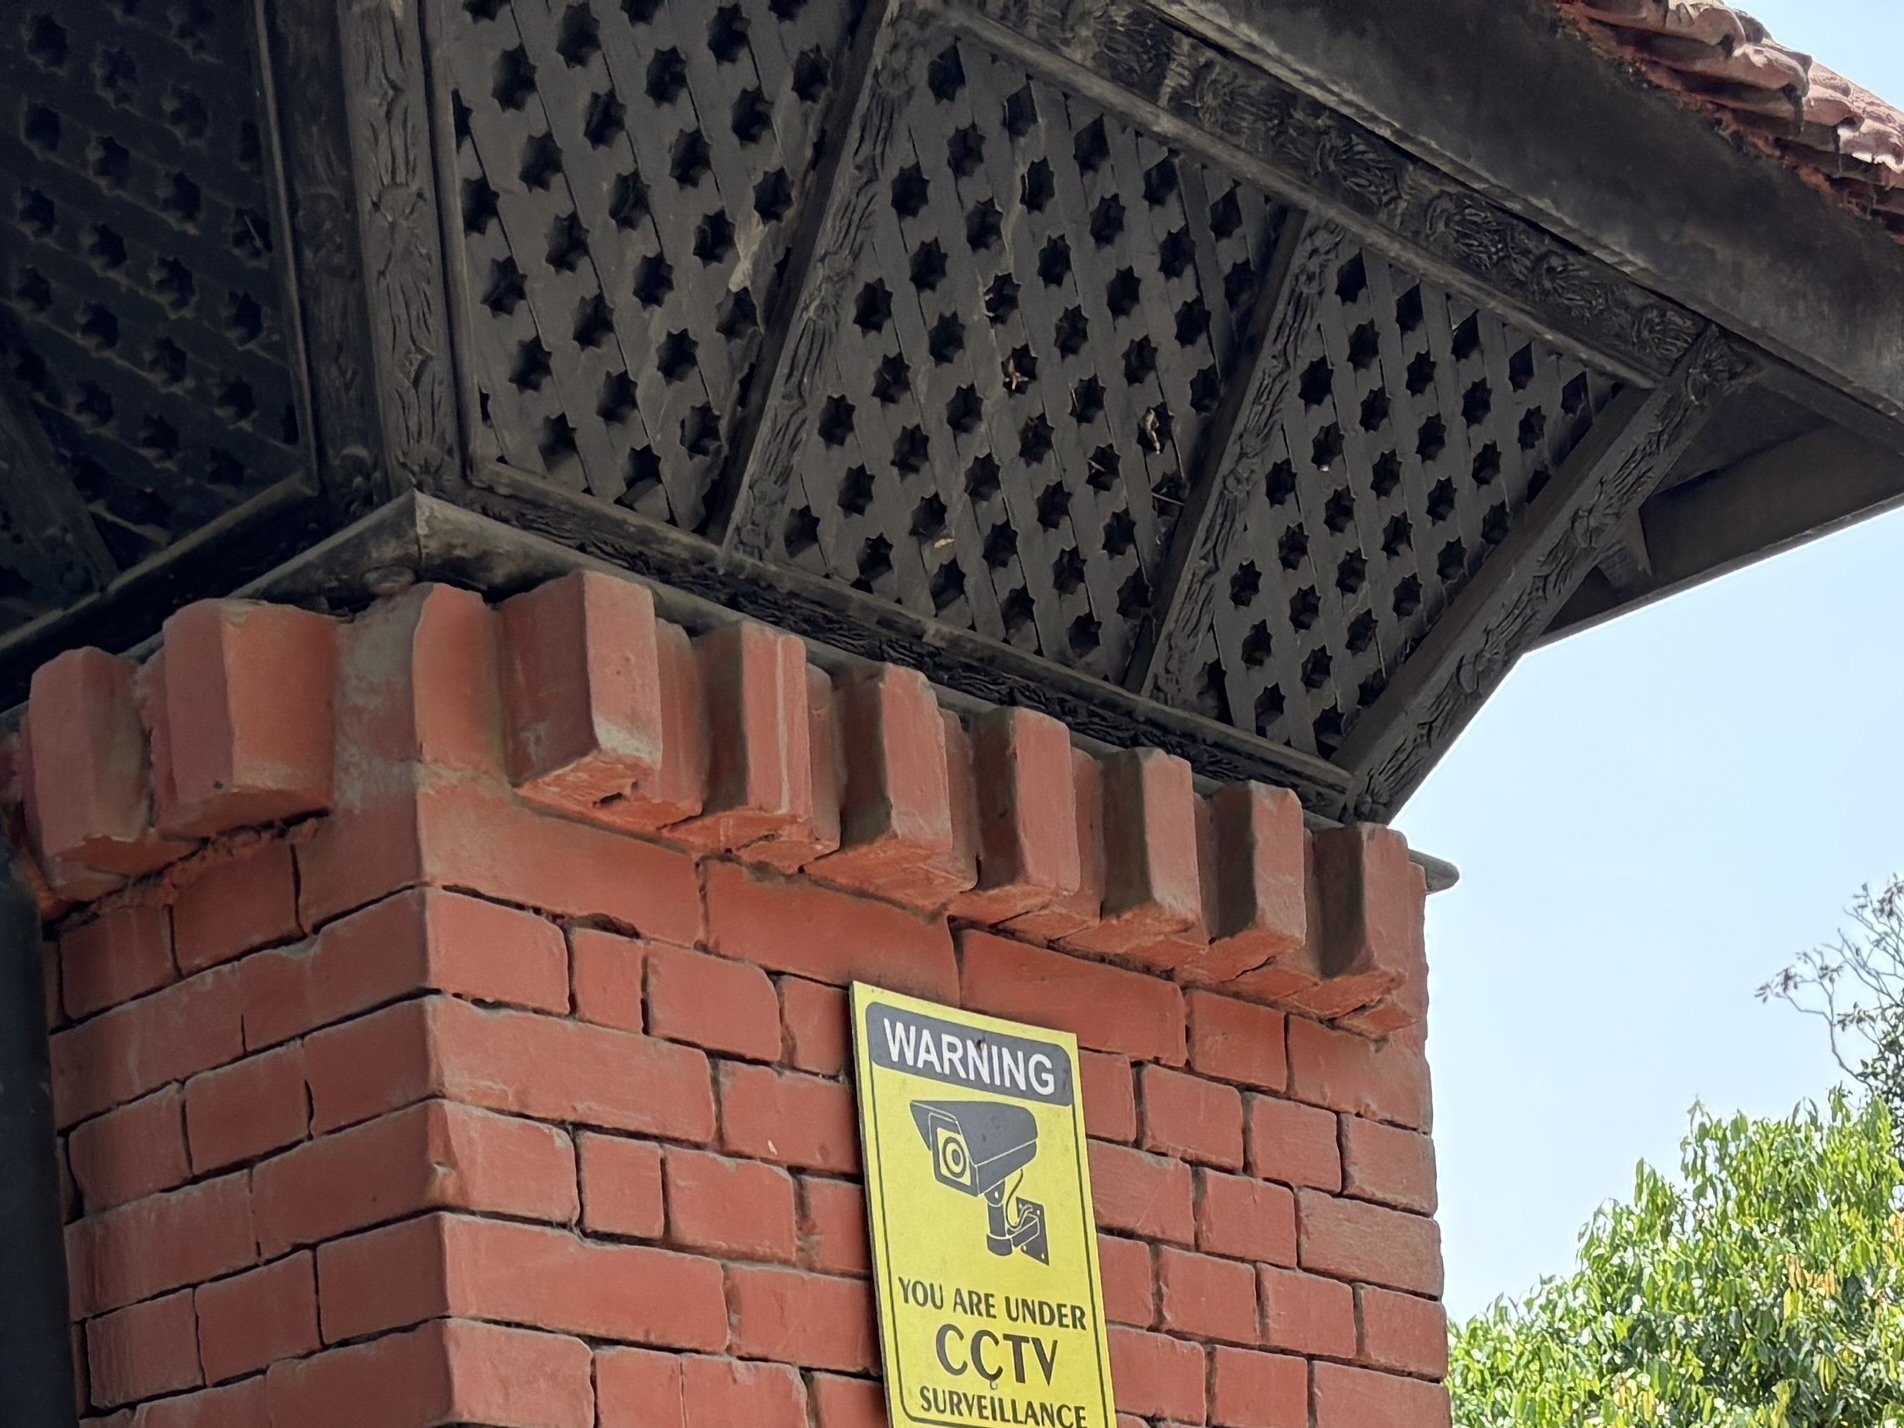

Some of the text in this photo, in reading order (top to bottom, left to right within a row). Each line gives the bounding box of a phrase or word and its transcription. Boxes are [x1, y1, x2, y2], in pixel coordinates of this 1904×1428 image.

[883, 1017, 1056, 1096] WARNING
[898, 1276, 1087, 1331] YOU ARE UNDER
[935, 1322, 1058, 1387] CCTV
